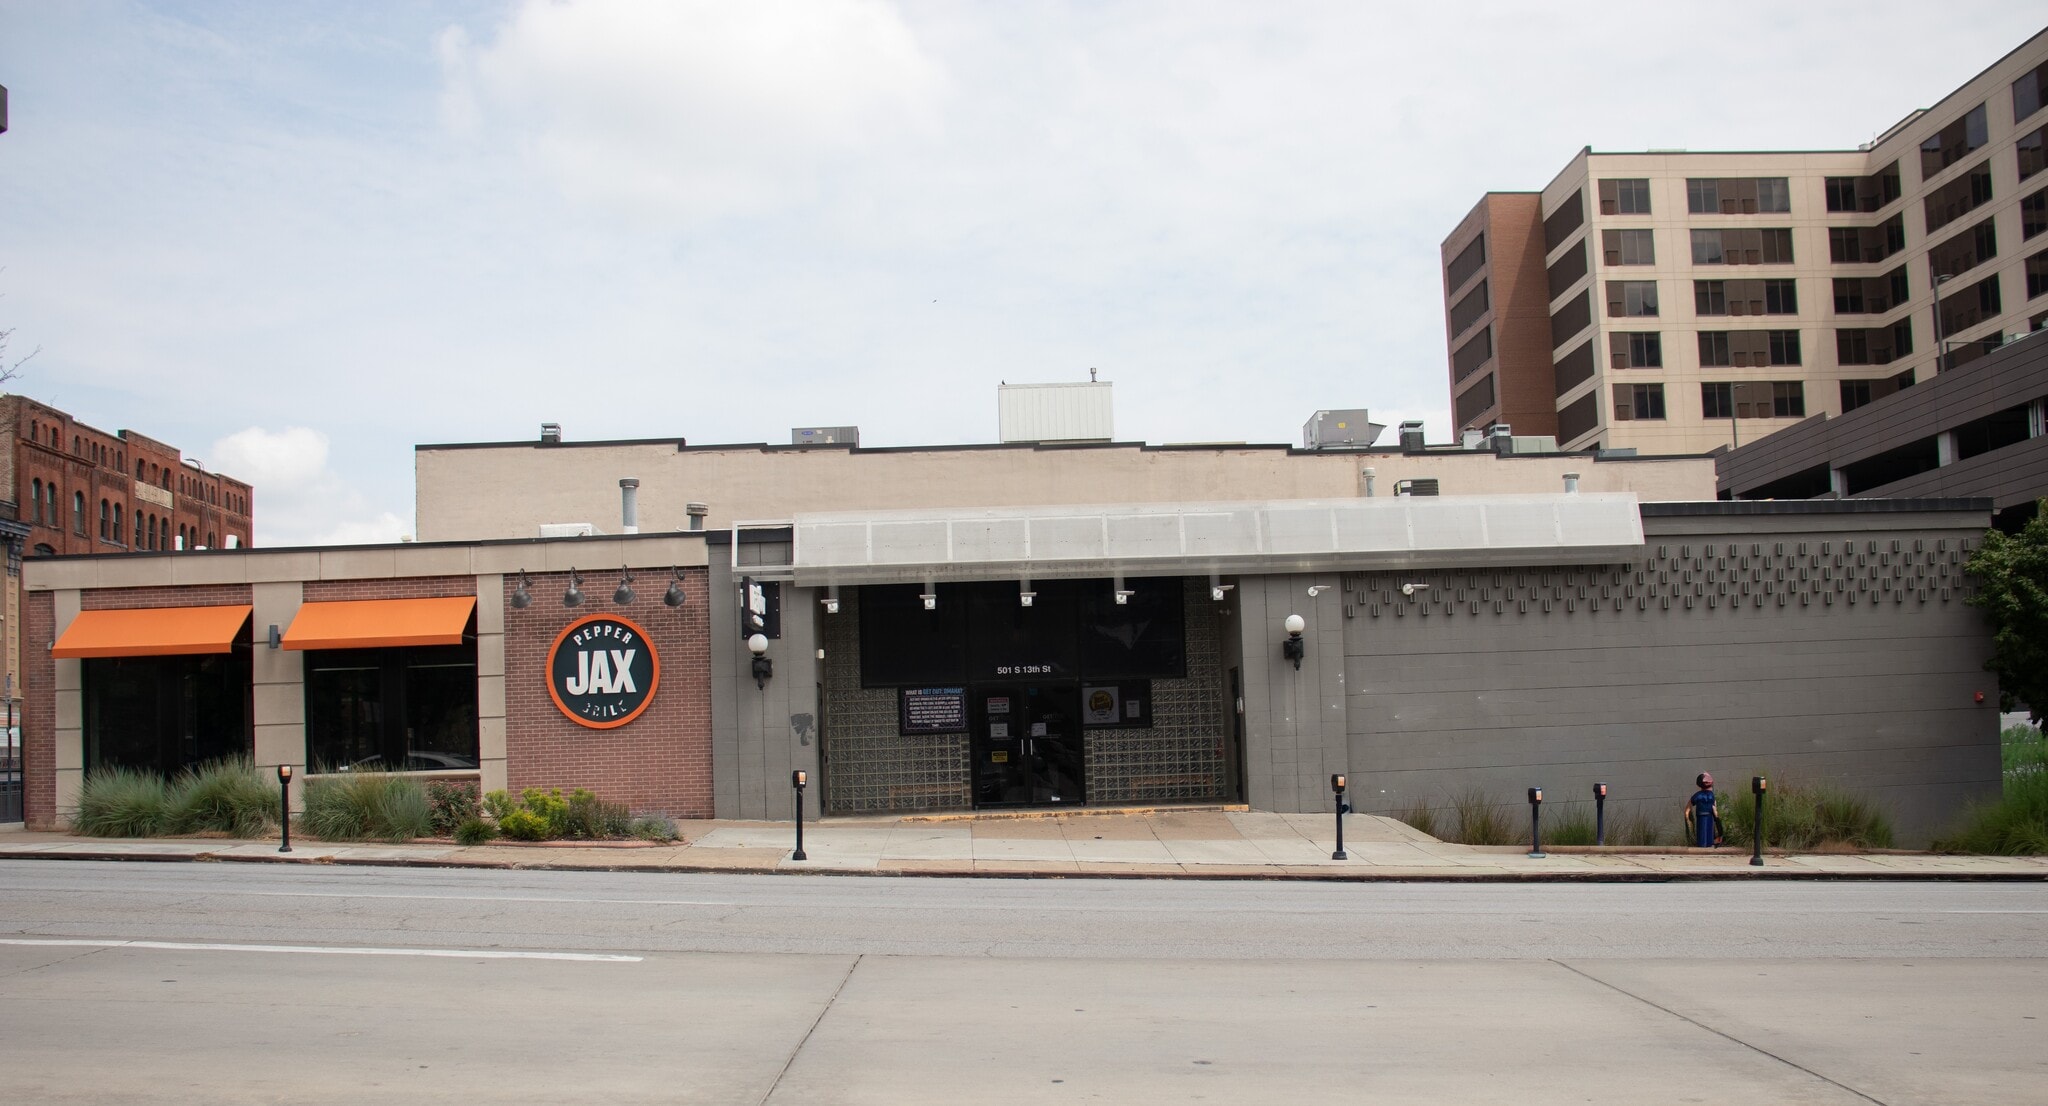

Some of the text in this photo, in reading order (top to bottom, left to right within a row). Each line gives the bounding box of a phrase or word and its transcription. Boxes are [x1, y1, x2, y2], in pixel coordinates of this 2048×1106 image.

[573, 625, 632, 646] PEPPER
[566, 649, 637, 695] JAX
[997, 665, 1051, 675] 501 S 13th St
